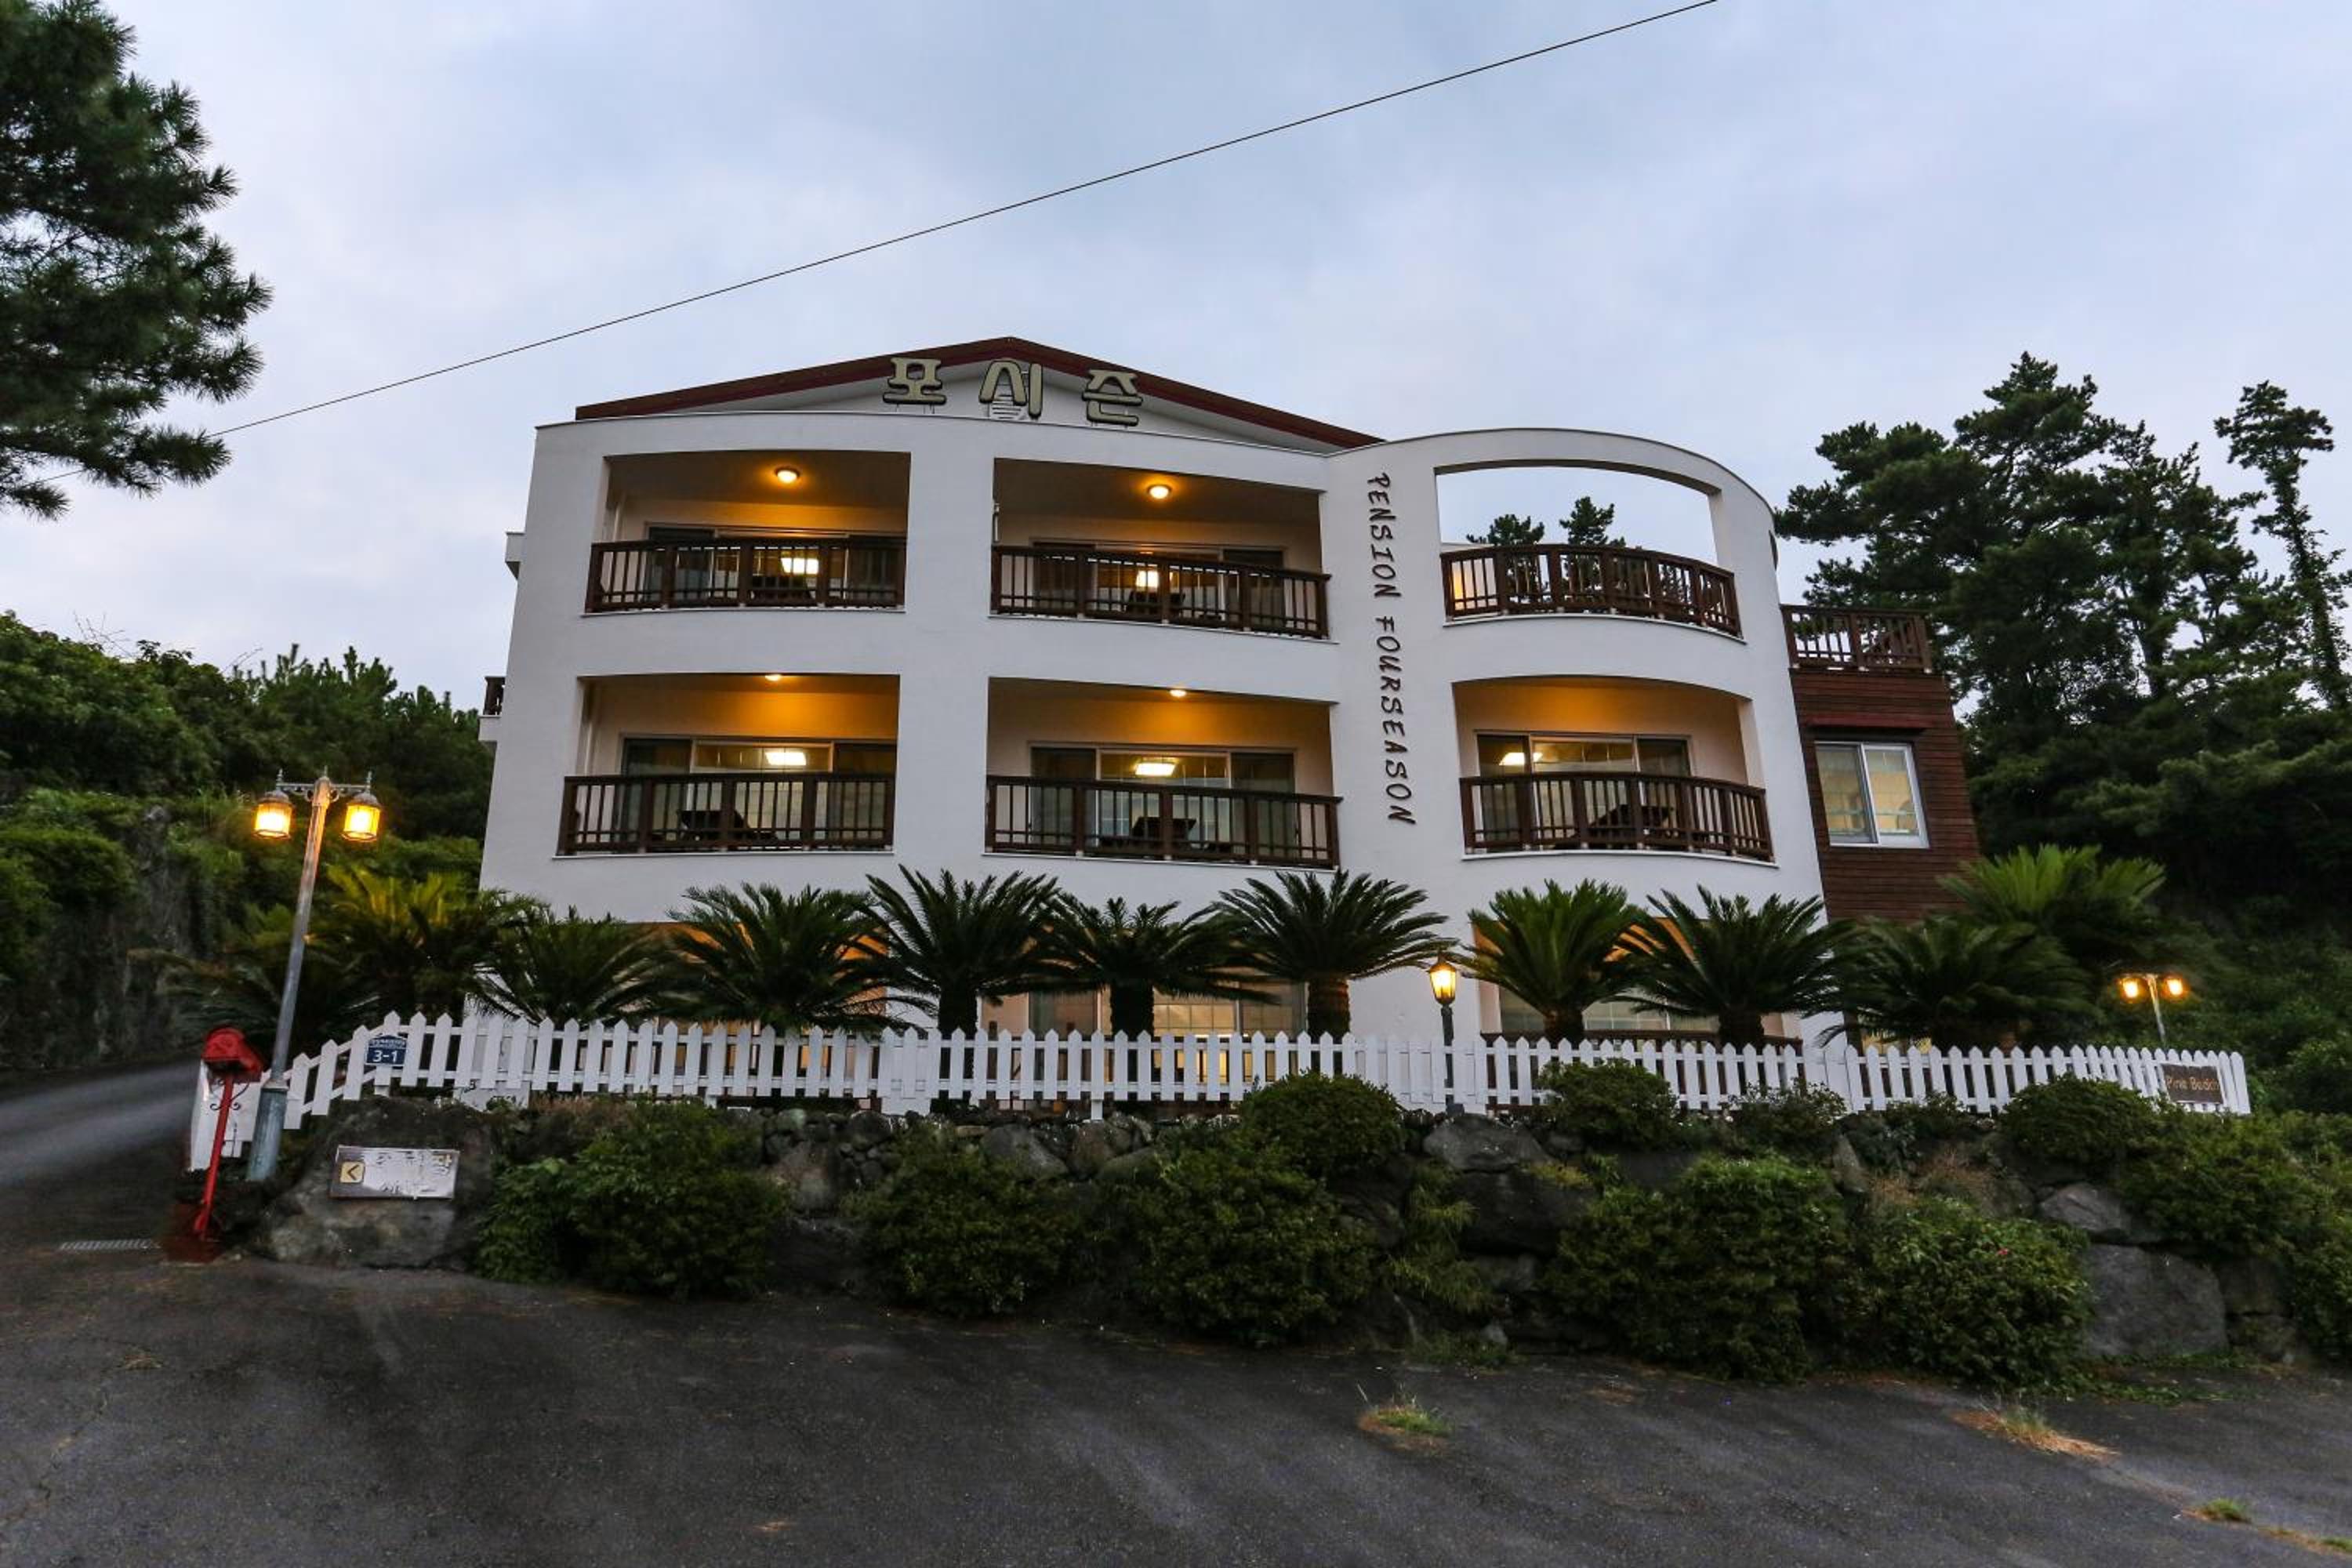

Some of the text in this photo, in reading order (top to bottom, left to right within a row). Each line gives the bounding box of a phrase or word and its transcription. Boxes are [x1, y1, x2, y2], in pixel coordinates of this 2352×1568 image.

[883, 357, 1144, 427] 포시즌
[1367, 472, 1417, 826] PENSION FOURSEASON
[372, 1050, 397, 1062] 3-1
